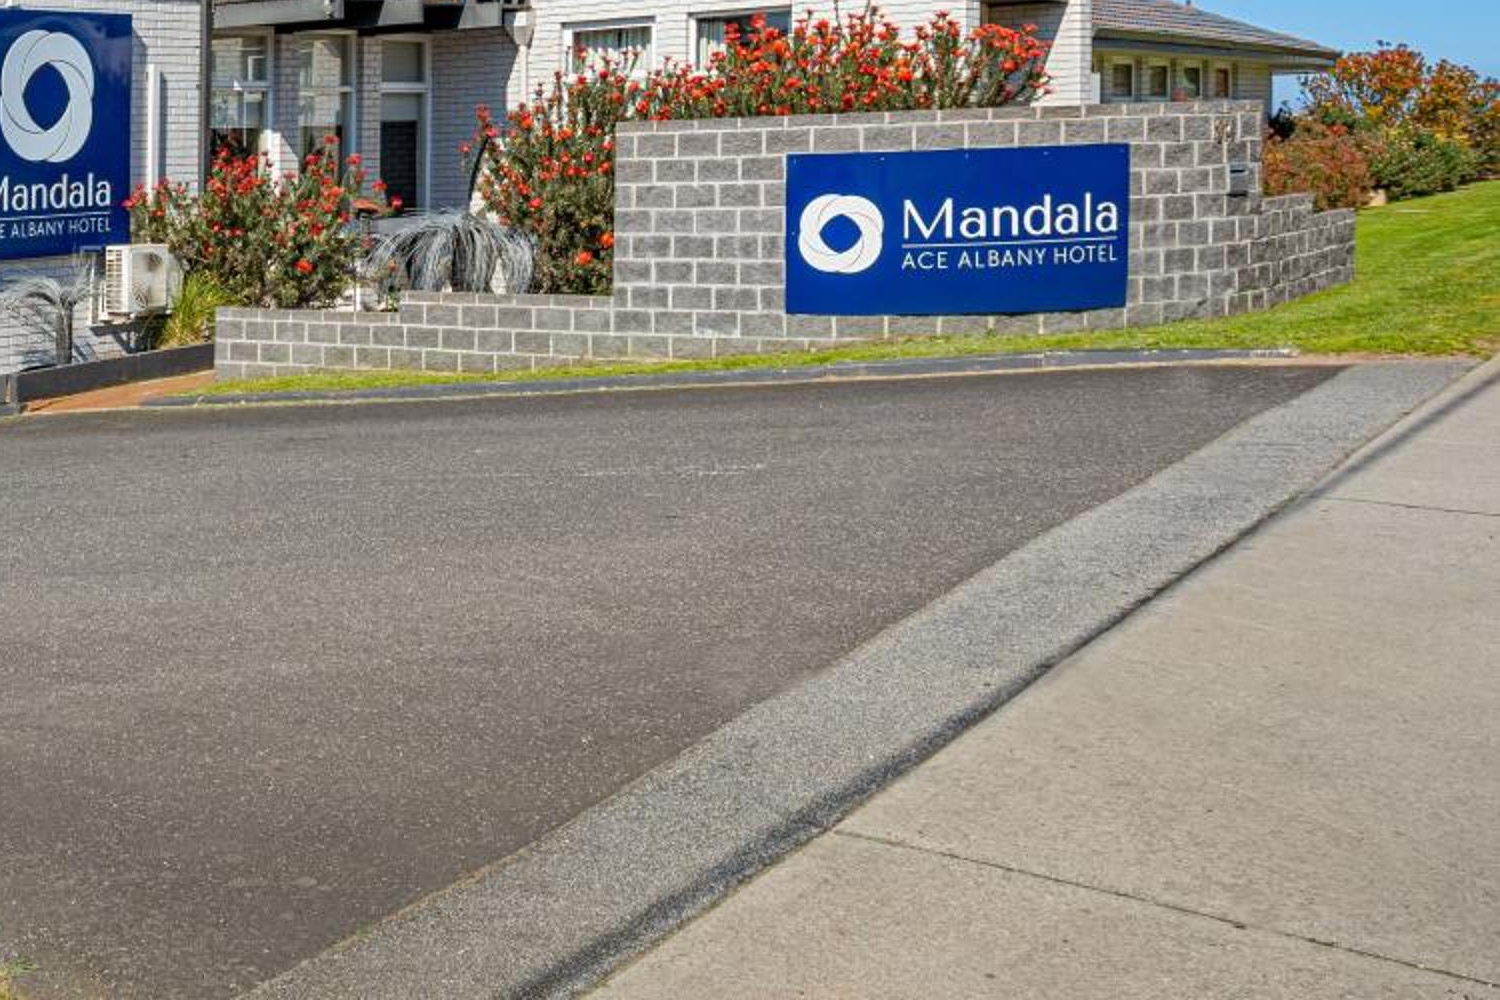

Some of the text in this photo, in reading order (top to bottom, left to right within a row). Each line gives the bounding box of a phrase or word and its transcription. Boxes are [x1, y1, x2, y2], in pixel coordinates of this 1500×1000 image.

[10, 220, 65, 238] ALBANY
[68, 217, 111, 233] HOTEL
[902, 192, 1119, 240] Mandala
[902, 245, 1117, 270] ACE ALBANY HOTEL
